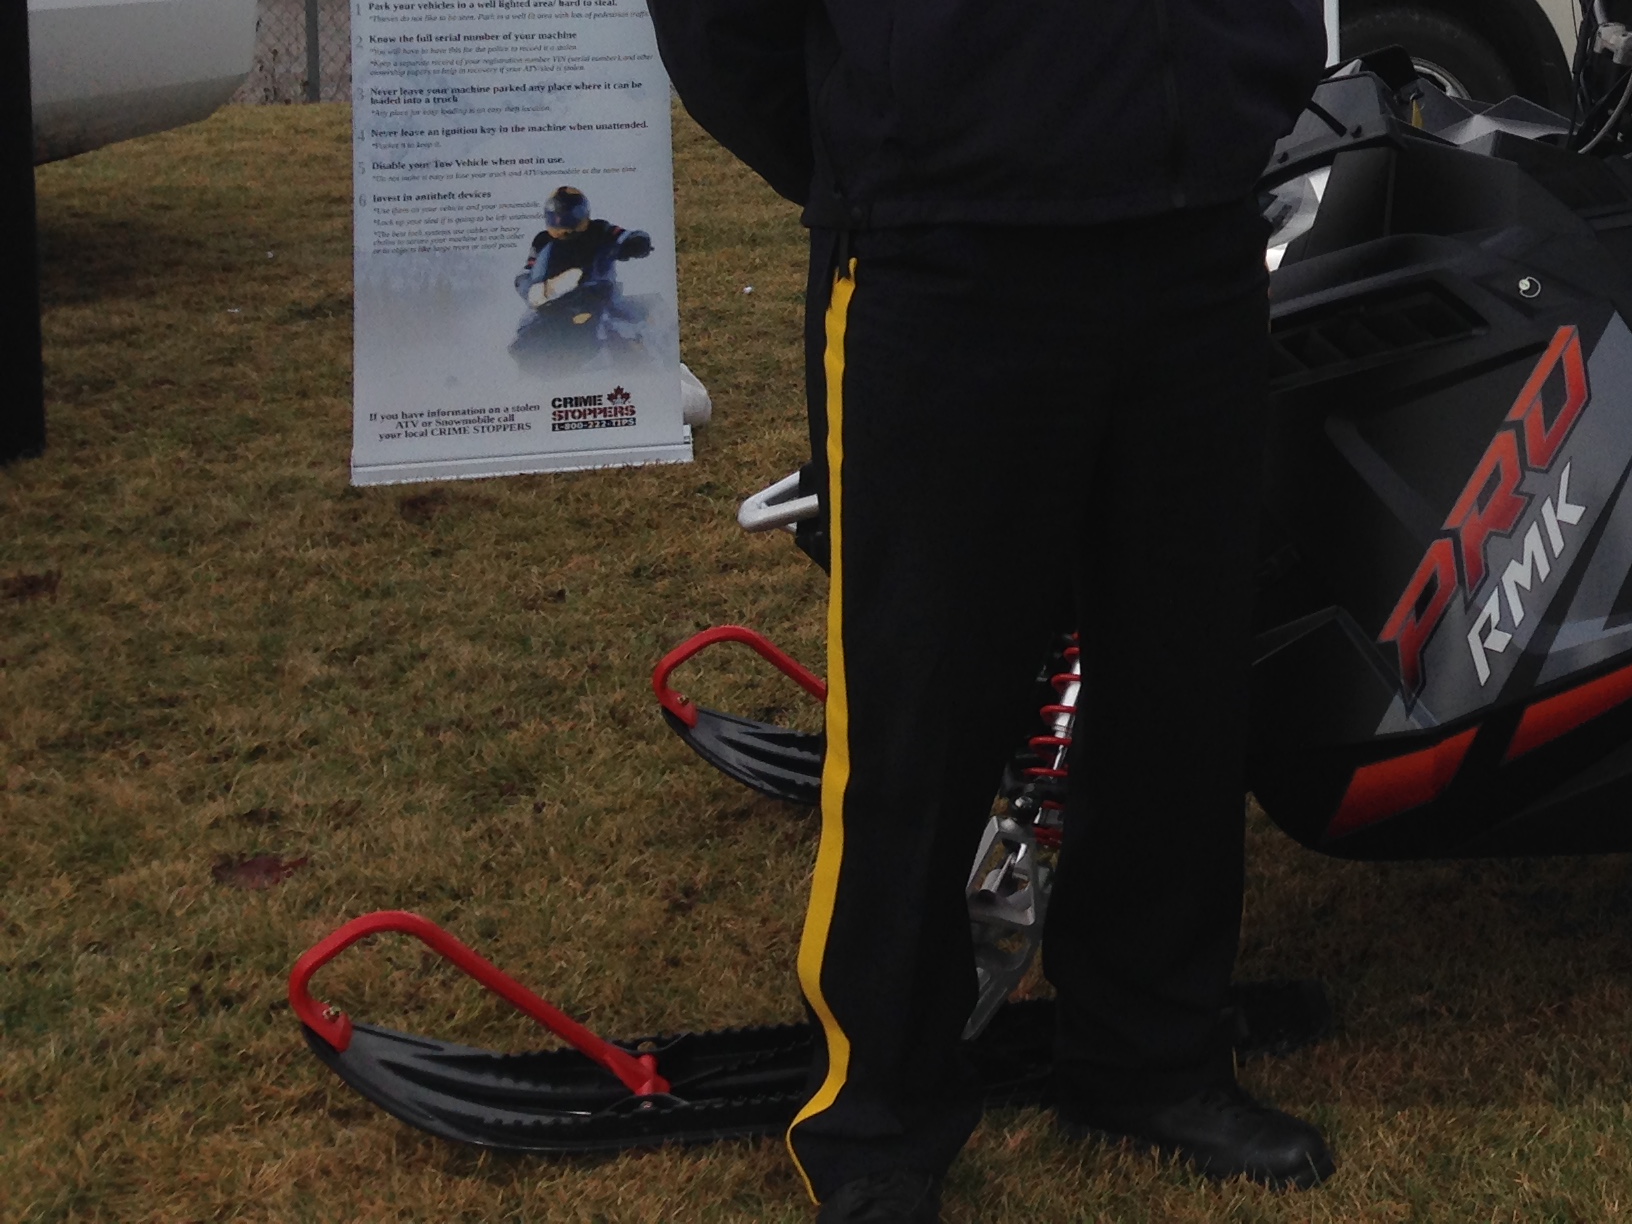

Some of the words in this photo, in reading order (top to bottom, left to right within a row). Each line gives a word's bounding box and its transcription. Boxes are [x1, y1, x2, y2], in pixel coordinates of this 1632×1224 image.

[369, 2, 389, 11] Park
[393, 2, 415, 12] your
[418, 0, 455, 10] vehicles
[477, 0, 496, 9] well
[369, 34, 396, 43] Know
[399, 34, 414, 43] the
[416, 33, 433, 42] full
[435, 32, 460, 42] serial
[463, 32, 499, 41] number
[502, 31, 512, 40] of
[514, 31, 536, 41] your
[538, 30, 577, 40] machine
[370, 87, 398, 97] Never
[400, 86, 423, 95] leave
[451, 84, 490, 94] machine
[493, 83, 526, 94] parked
[528, 84, 545, 95] any
[548, 83, 571, 93] place
[574, 81, 602, 90] where
[604, 81, 611, 90] it
[613, 82, 629, 90] can
[631, 80, 642, 89] be
[370, 96, 400, 105] loaded
[403, 96, 422, 105] into
[433, 94, 458, 103] truck
[371, 128, 398, 138] Never
[400, 128, 424, 137] leave
[428, 128, 439, 136] an
[442, 126, 478, 137] ignition
[480, 125, 496, 136] key
[511, 124, 525, 132] the
[528, 123, 566, 132] machine
[569, 122, 593, 131] when
[372, 161, 405, 170] Disable
[408, 161, 430, 172] your
[455, 158, 489, 167] Vehicle
[491, 157, 516, 166] when
[535, 156, 545, 164] in
[373, 194, 400, 203] Invest
[458, 190, 492, 200] devices
[551, 395, 603, 409] CRIME
[369, 412, 378, 422] If
[381, 412, 398, 423] you
[401, 409, 424, 420] have
[426, 406, 485, 419] information
[489, 406, 501, 414] on
[511, 402, 540, 414] stolen
[551, 405, 636, 421] STOPPERS
[395, 420, 418, 430] ATV
[421, 420, 432, 428] or
[435, 414, 495, 427] Snowmobile
[498, 412, 515, 423] call
[379, 431, 401, 442] your
[404, 428, 428, 439] local
[431, 426, 470, 437] CRIME
[473, 421, 532, 435] STOPPERS
[1377, 325, 1590, 721] PRO
[1467, 461, 1586, 686] RMK
